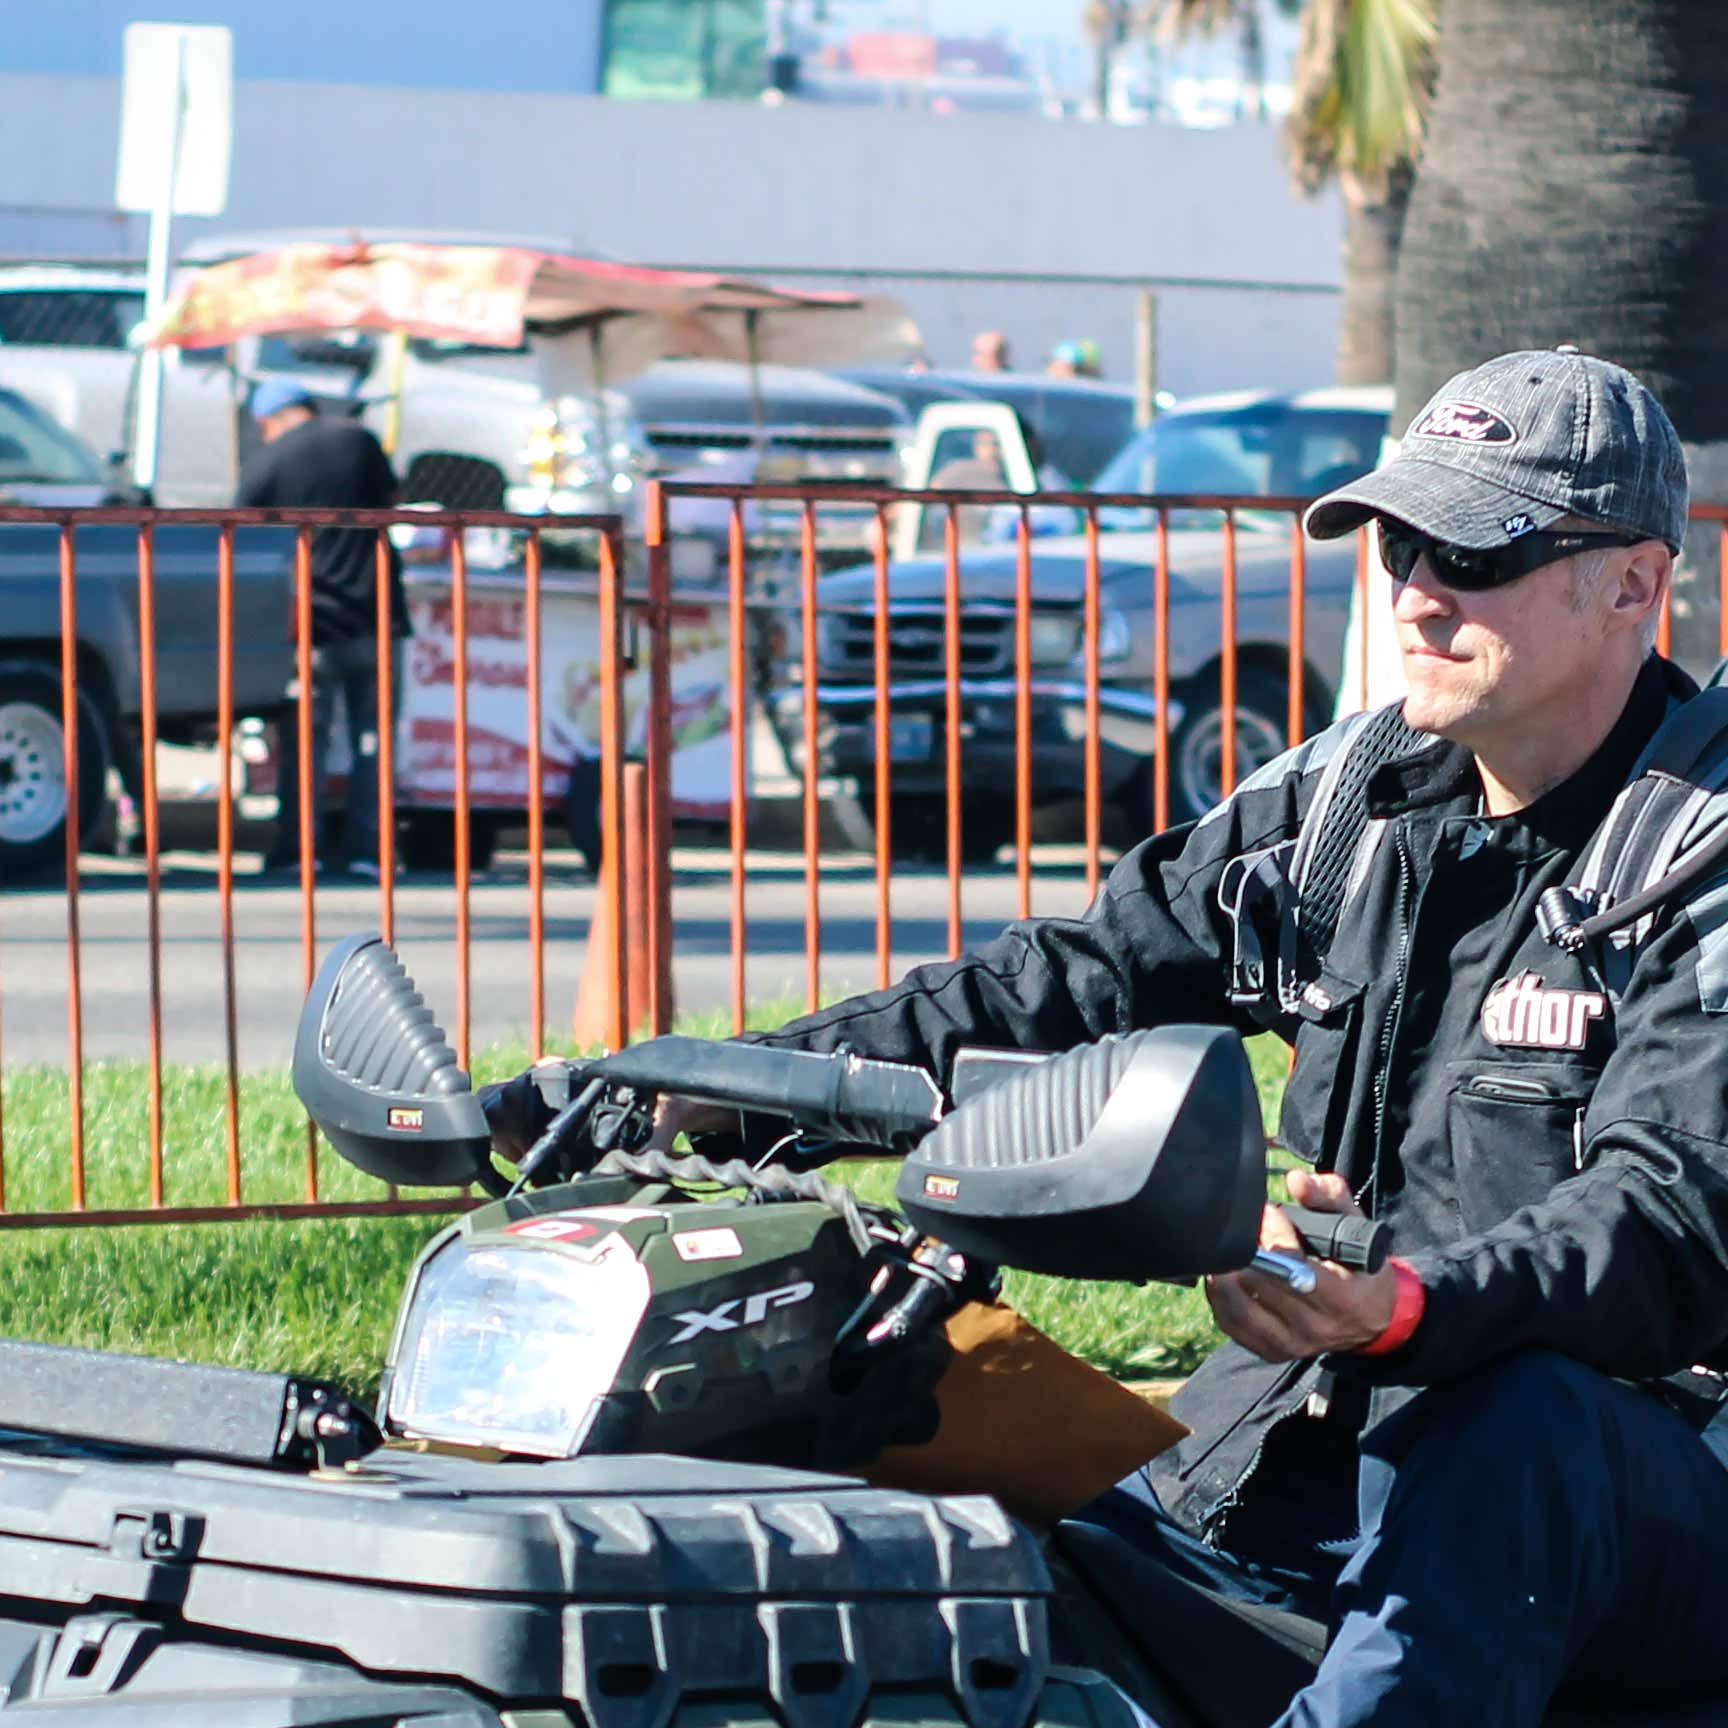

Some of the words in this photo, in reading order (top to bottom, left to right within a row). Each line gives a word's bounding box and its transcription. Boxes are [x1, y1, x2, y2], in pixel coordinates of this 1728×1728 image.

[1418, 403, 1496, 440] Ford
[1499, 974, 1606, 1048] thor
[667, 1281, 815, 1345] XP
